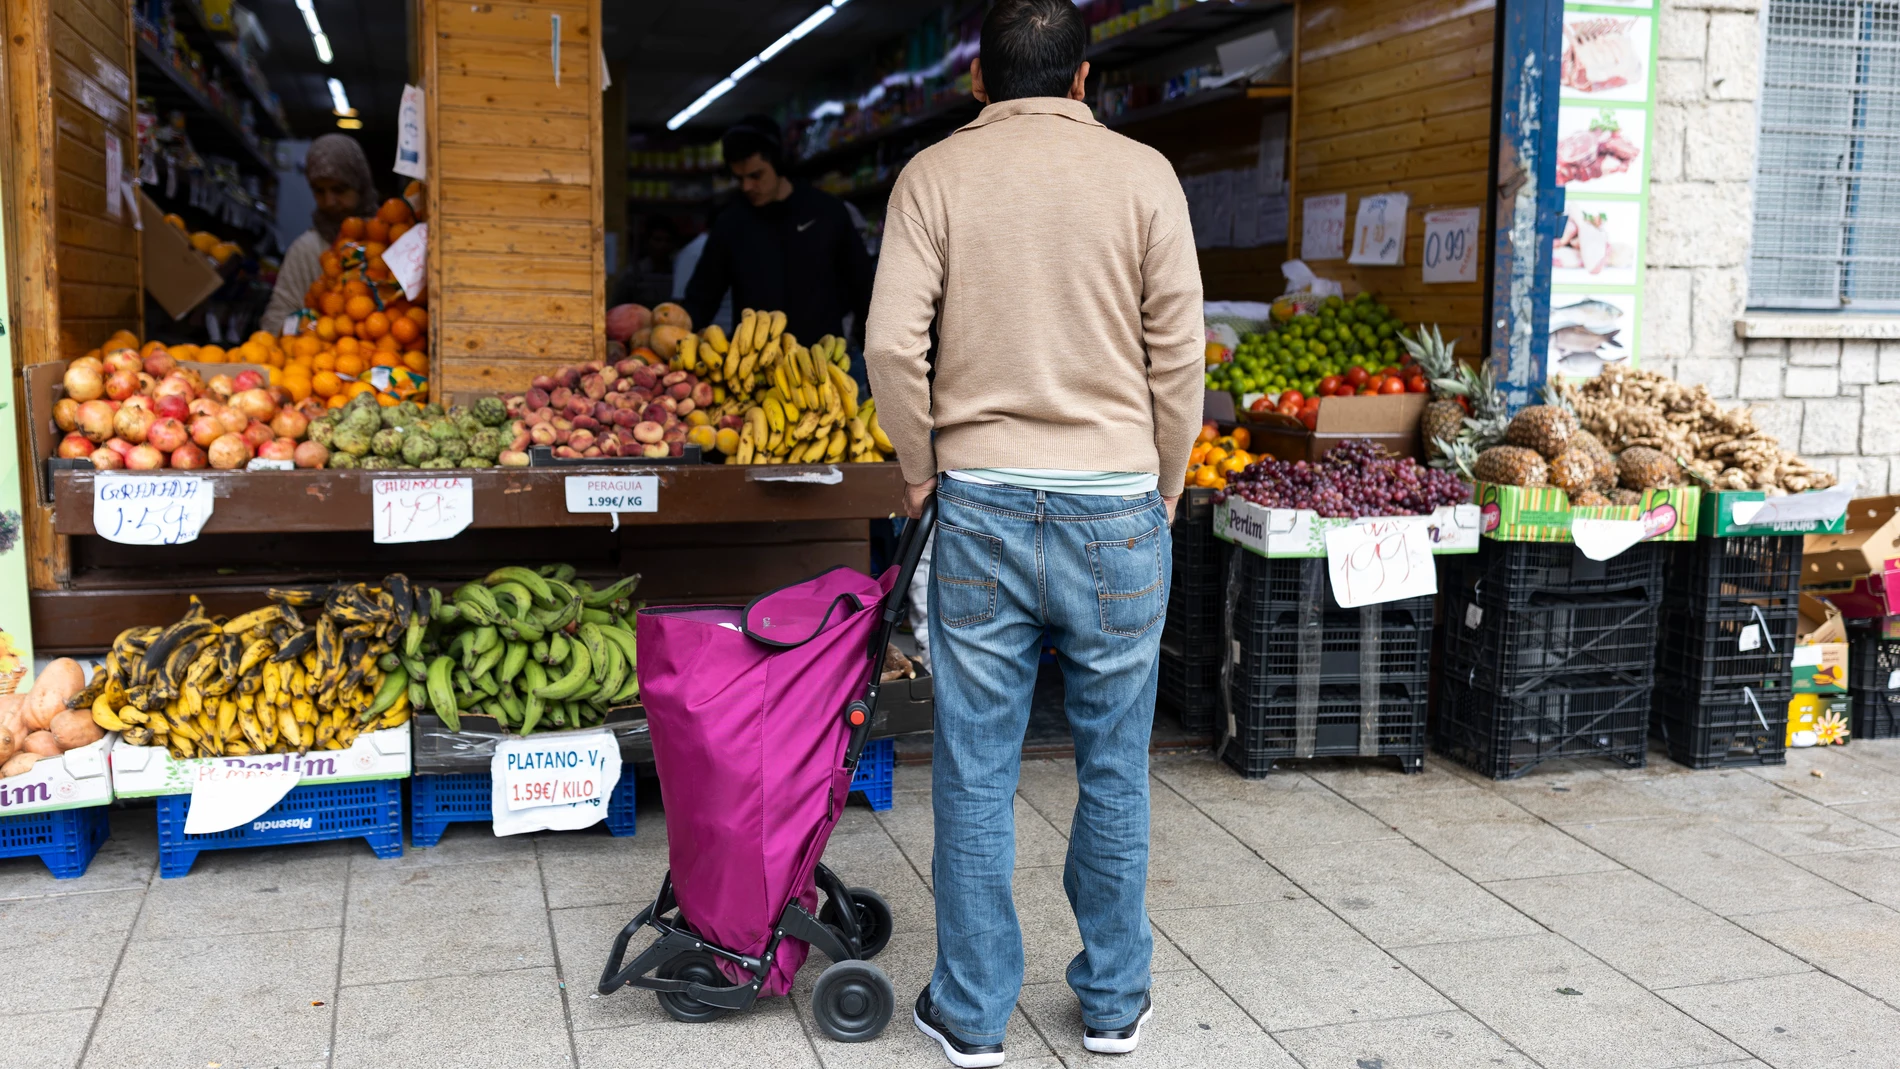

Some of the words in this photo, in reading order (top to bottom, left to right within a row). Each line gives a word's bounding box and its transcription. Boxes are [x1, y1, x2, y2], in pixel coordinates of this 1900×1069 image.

[588, 481, 643, 491] PERAGUIA
[588, 495, 624, 508] 1.99€/
[628, 496, 643, 506] KG
[1229, 509, 1263, 540] Perlim
[507, 751, 583, 770] PLATANO-
[513, 779, 558, 803] 1.59€/
[563, 780, 593, 799] KILO
[253, 816, 313, 832] Plasencia
